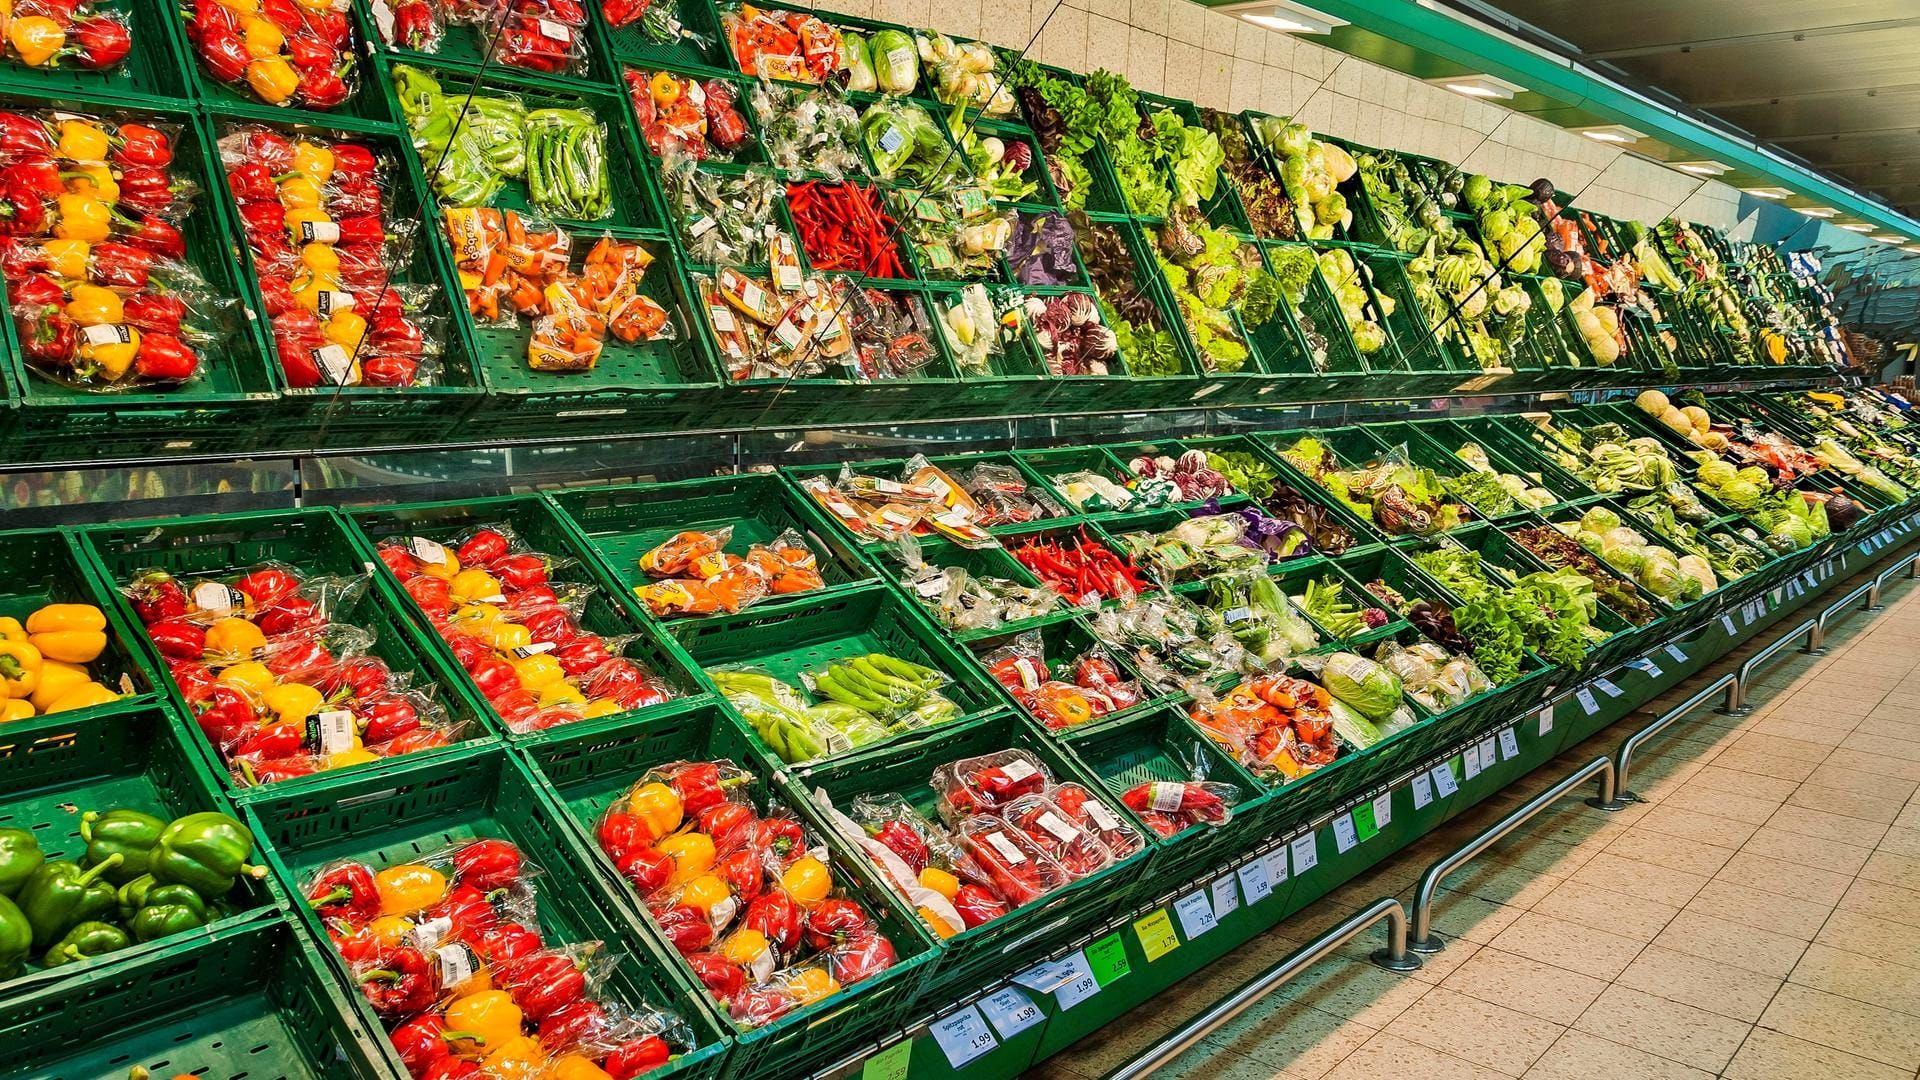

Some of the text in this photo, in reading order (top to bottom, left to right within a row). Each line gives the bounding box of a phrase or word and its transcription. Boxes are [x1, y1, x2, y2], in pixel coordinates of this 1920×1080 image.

[1199, 913, 1213, 926] 2.29
[1162, 934, 1176, 948] 1.79
[1112, 959, 1126, 972] 2.59
[1076, 978, 1093, 993] 1.99
[992, 993, 1010, 1004] Paprika
[1016, 1007, 1036, 1022] 1.99
[942, 1013, 971, 1031] Spitzpaprika
[971, 1032, 991, 1049] 1.99
